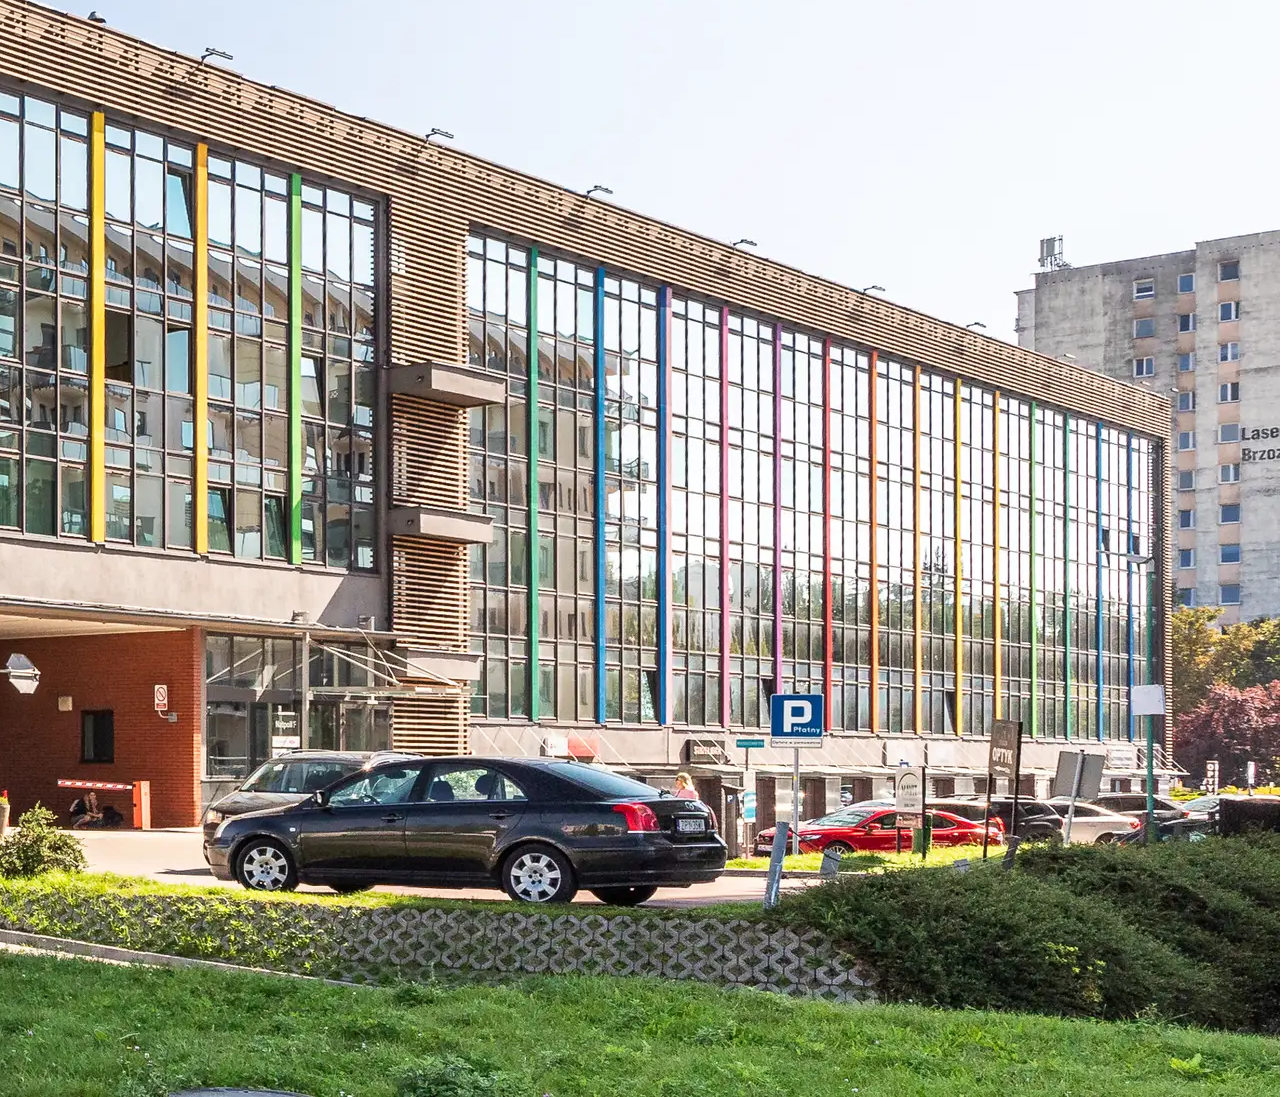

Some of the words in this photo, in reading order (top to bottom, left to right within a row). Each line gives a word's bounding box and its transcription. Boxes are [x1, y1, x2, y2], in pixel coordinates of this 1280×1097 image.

[783, 700, 812, 733] P
[793, 726, 820, 735] Płatny
[992, 747, 1013, 765] OPTYK
